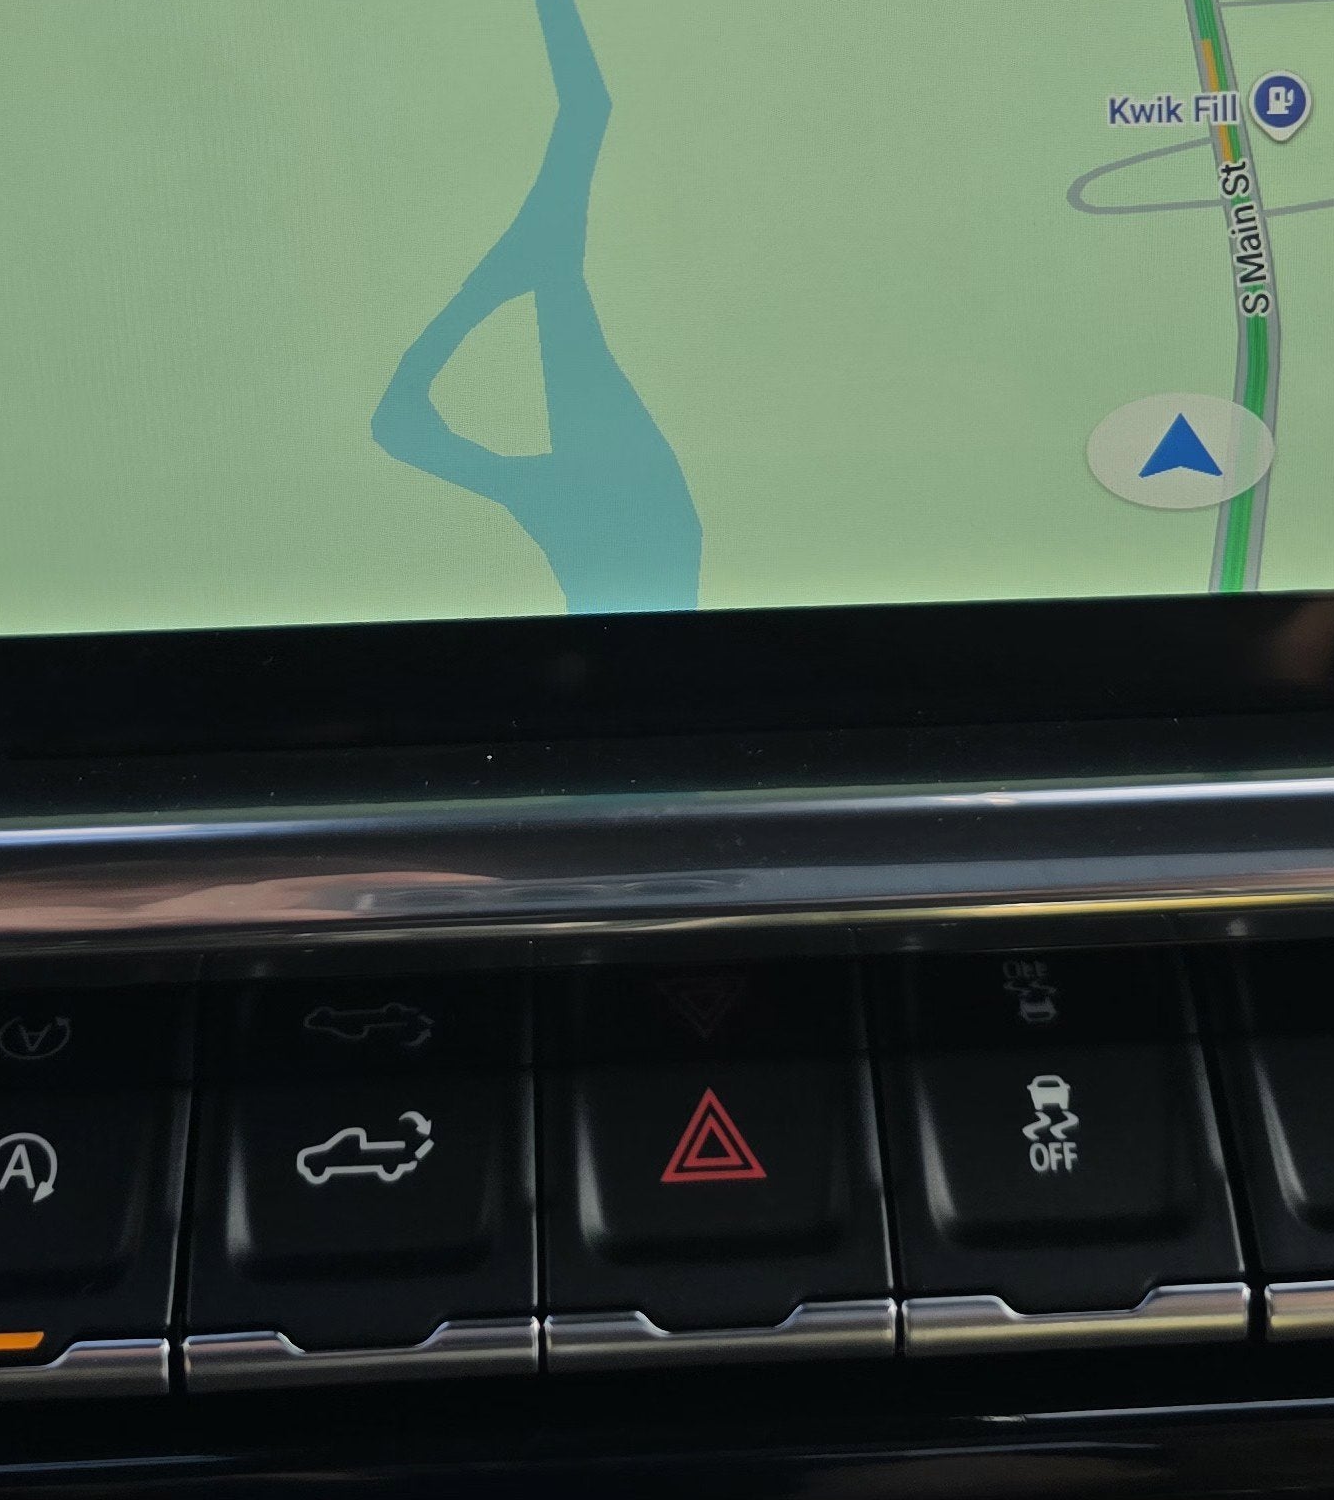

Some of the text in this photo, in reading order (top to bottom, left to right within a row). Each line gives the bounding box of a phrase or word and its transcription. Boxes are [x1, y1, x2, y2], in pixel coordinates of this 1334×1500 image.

[1109, 93, 1239, 124] Kwik Fill
[1220, 159, 1270, 315] S Main St
[1029, 1141, 1078, 1173] OFF
